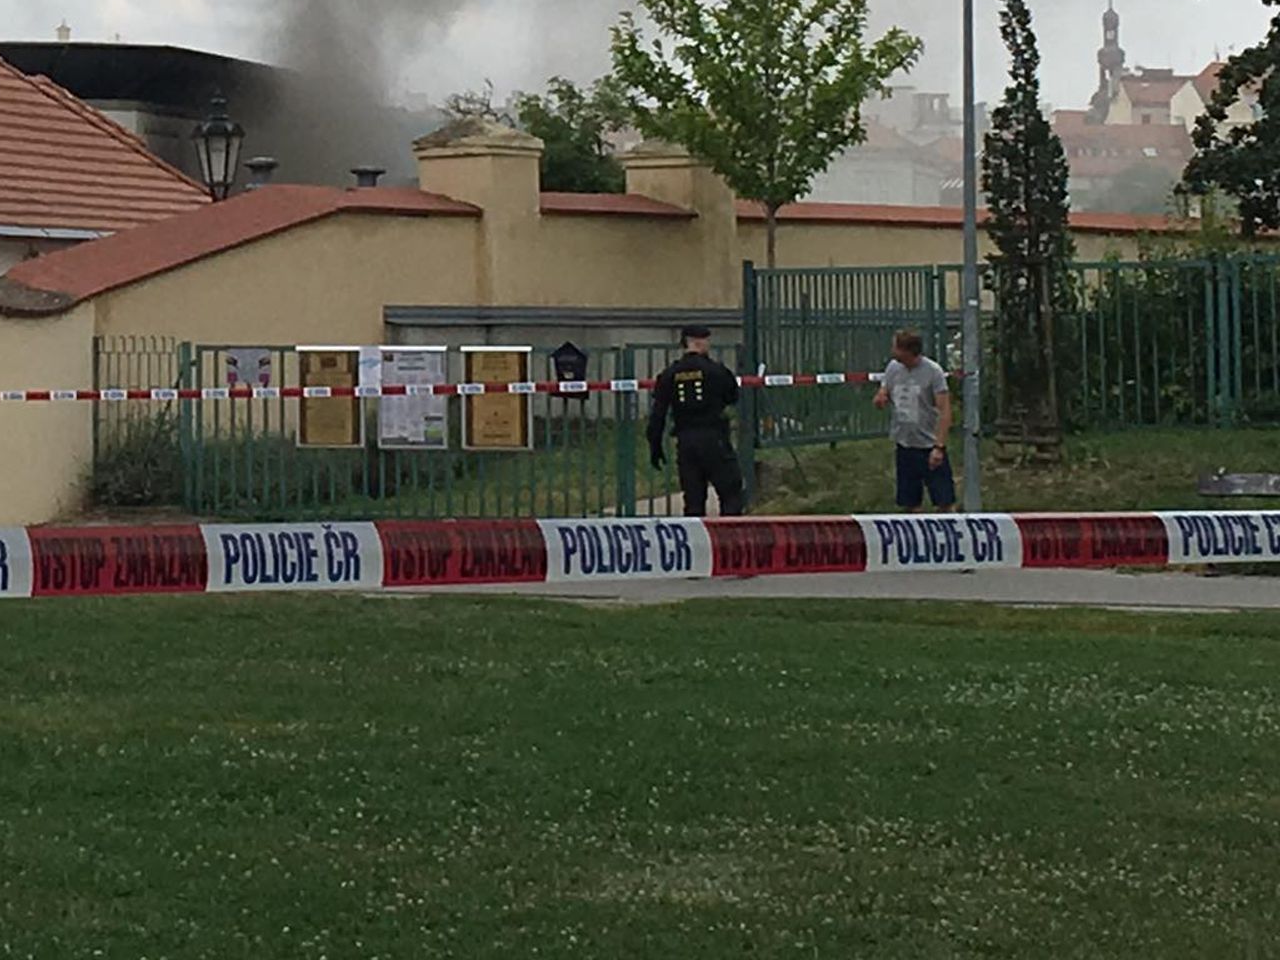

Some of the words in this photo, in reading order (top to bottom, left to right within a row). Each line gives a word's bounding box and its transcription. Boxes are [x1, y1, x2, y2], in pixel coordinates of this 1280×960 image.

[220, 531, 319, 584] POLICIE
[322, 524, 361, 582] ČR
[557, 524, 653, 574] POLICIE
[873, 519, 966, 565] POLICIE
[1173, 515, 1263, 556] POLICIE
